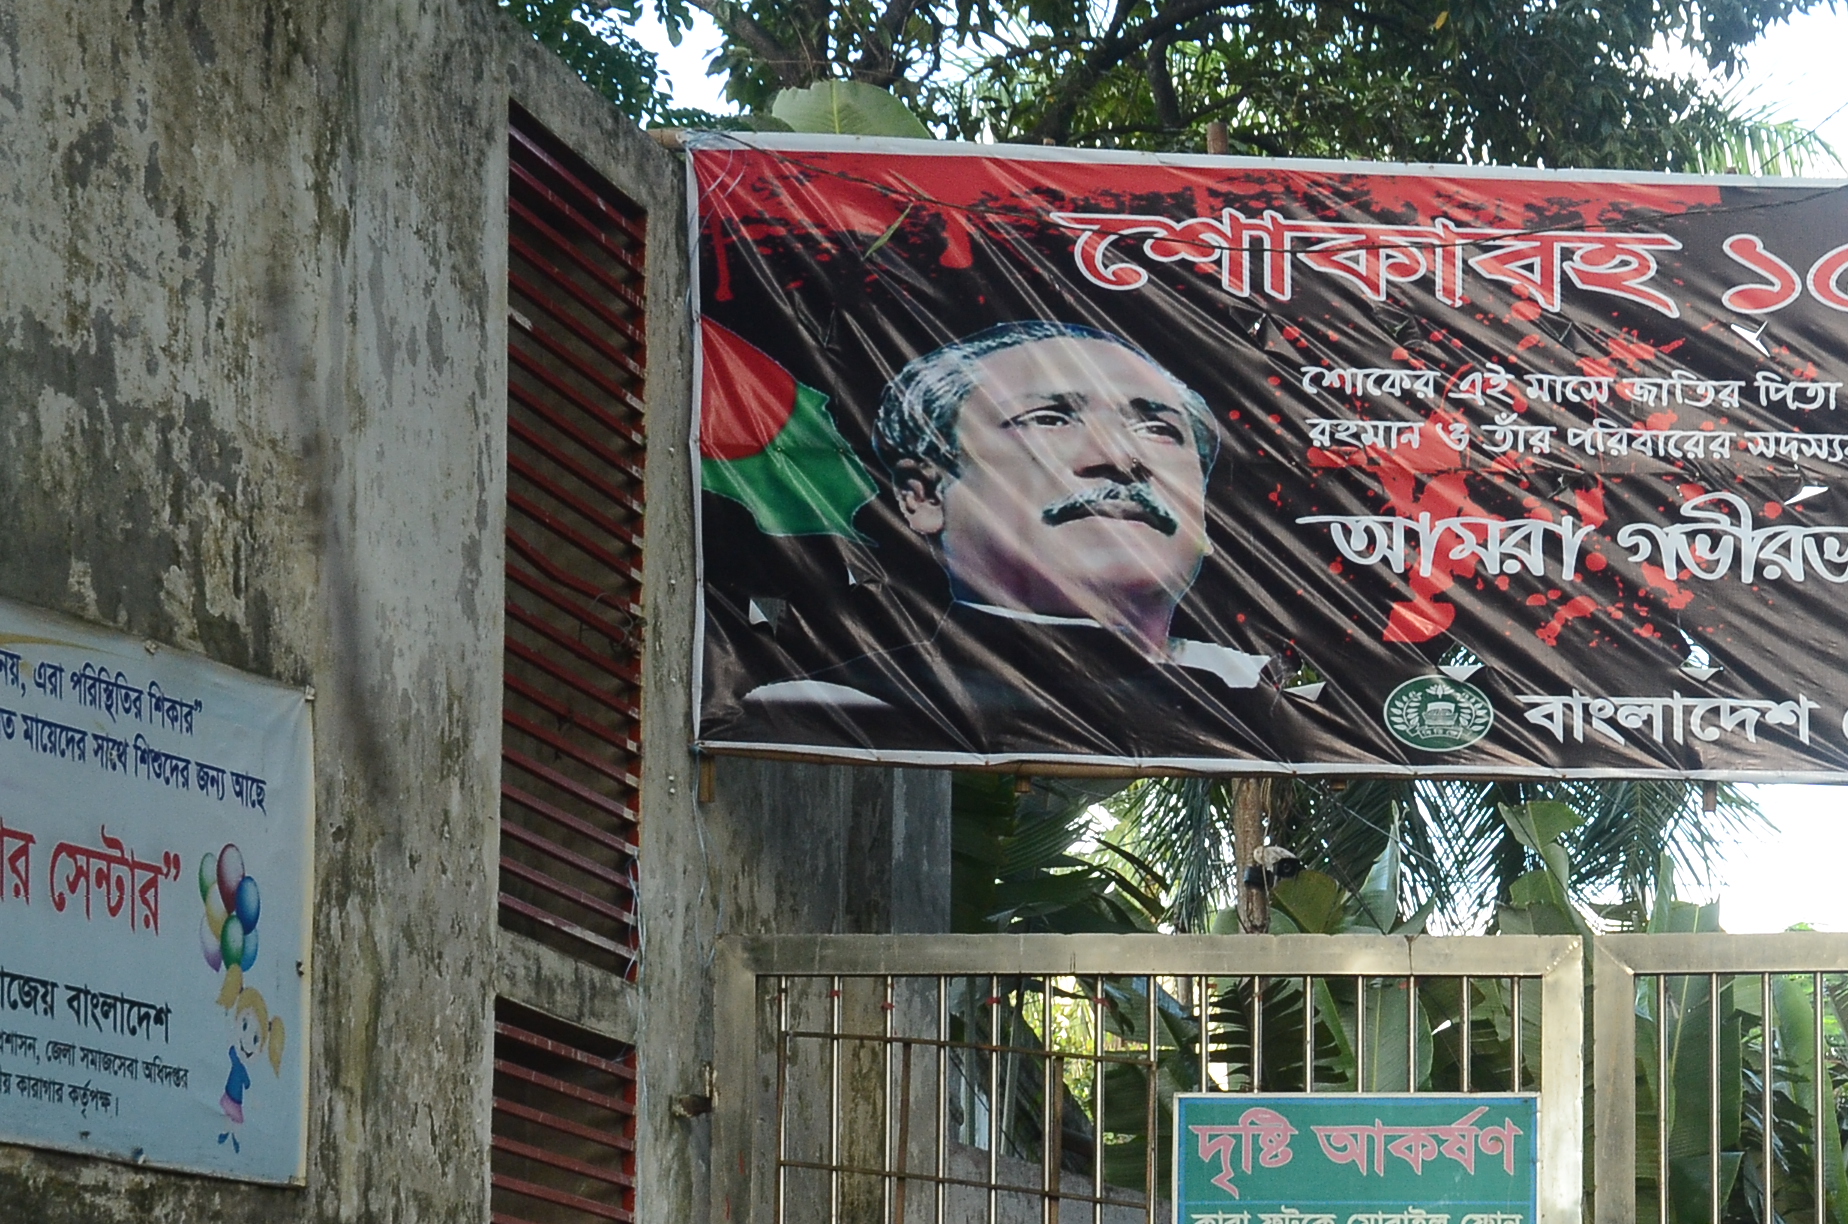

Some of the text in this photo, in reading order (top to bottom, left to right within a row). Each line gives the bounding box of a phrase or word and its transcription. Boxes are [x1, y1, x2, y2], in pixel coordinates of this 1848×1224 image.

[1050, 207, 1681, 318] শোকাবহ
[1300, 365, 1441, 399] শোকের
[1448, 362, 1515, 405] এই
[1524, 373, 1615, 404] মাসে
[1624, 370, 1745, 408] জাতির
[1754, 371, 1842, 410] পিতা
[1306, 417, 1423, 450] রহমান
[1436, 421, 1470, 452] ও
[1481, 412, 1557, 454] তাঁর
[1567, 418, 1736, 459] পরিবারের
[1296, 510, 1596, 581] আমরা
[33, 661, 66, 701] এরা
[70, 661, 145, 724] পরিস্থিতির
[1517, 689, 1821, 748] বাংলাদেশ
[21, 713, 89, 765] মায়েদের
[92, 732, 129, 775] সাথে
[133, 733, 191, 791] শিশুদের
[195, 761, 227, 801] জন্য
[230, 771, 268, 817] আছে
[50, 823, 182, 938] সেন্টার”
[64, 983, 173, 1045] বাংলাদেশ
[16, 1073, 65, 1105] কারাগার
[46, 1040, 77, 1068] জেলা
[79, 1045, 140, 1082] সমাজসেবা
[1188, 1105, 1524, 1200] দৃষ্টি আকর্ষণ
